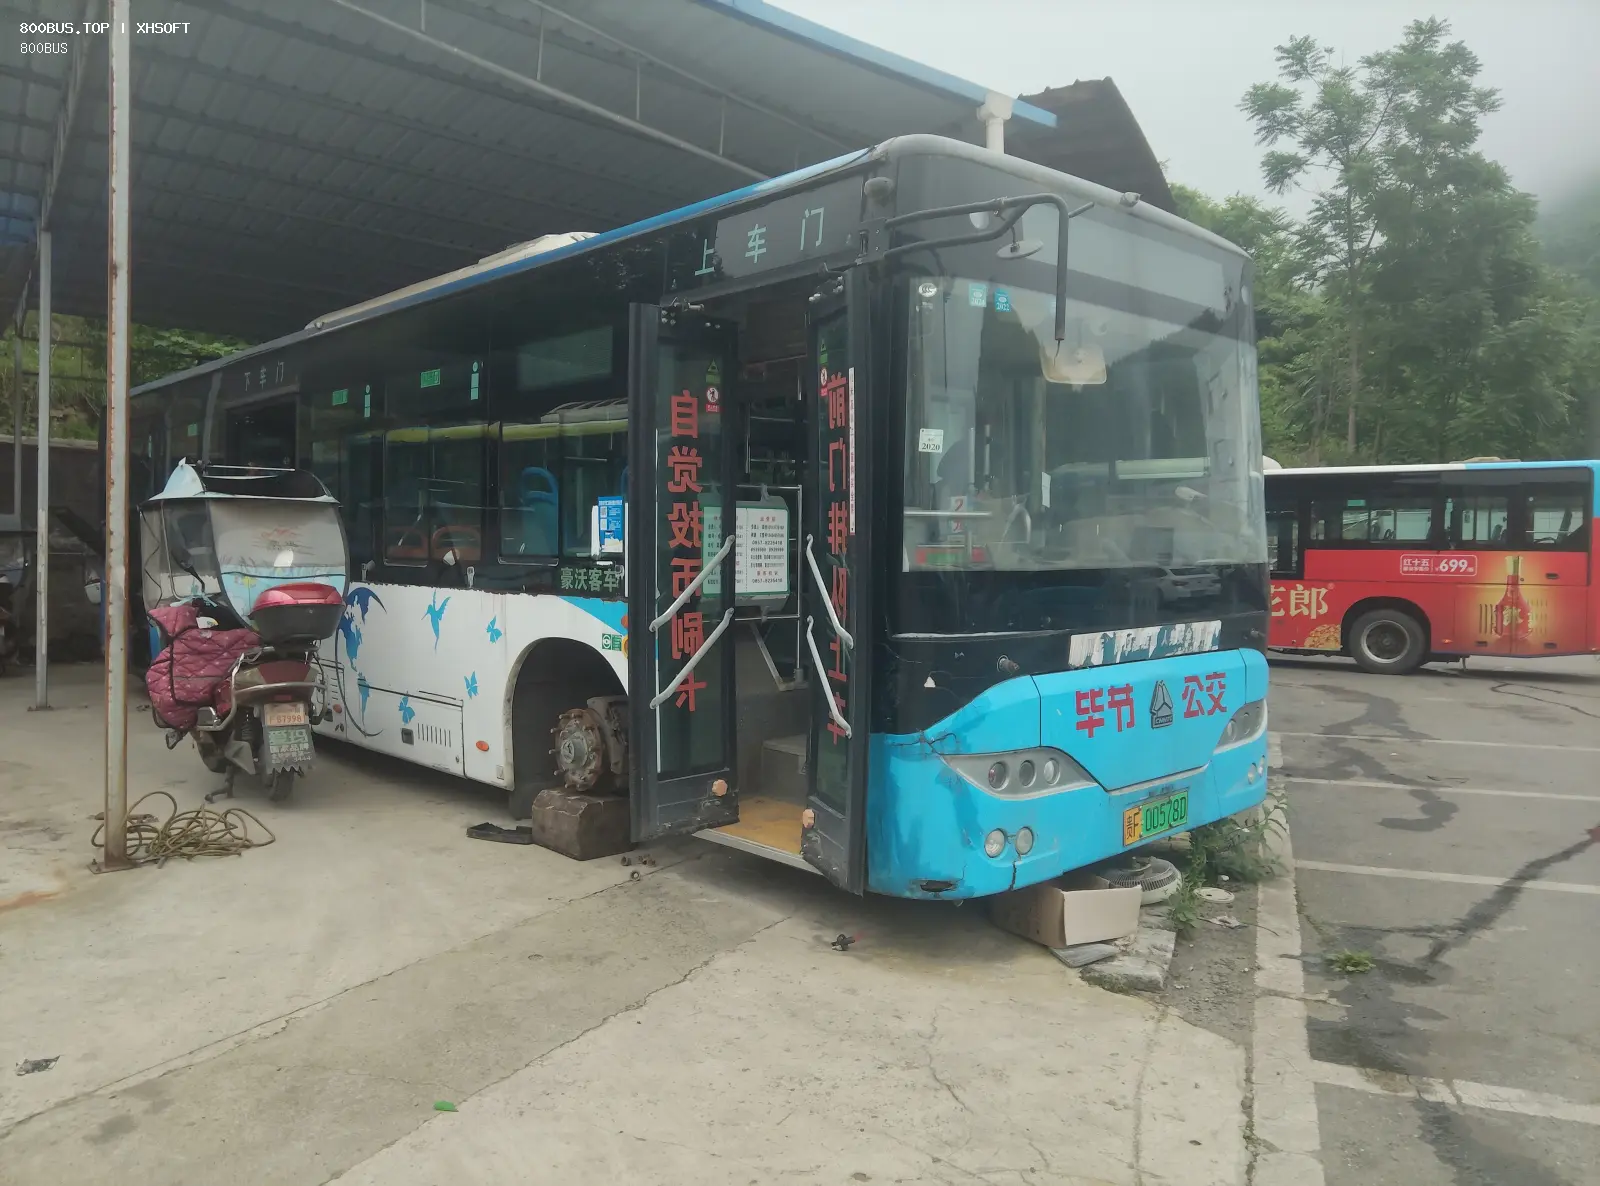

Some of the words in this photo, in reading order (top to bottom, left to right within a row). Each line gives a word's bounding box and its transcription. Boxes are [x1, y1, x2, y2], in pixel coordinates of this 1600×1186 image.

[694, 206, 825, 276] 上车门
[244, 360, 285, 392] 下车门
[921, 442, 941, 451] 2020
[1403, 558, 1430, 566] 红十五
[560, 566, 618, 593] 豪沃客车
[1075, 683, 1136, 739] 毕节
[1181, 671, 1228, 719] 公交
